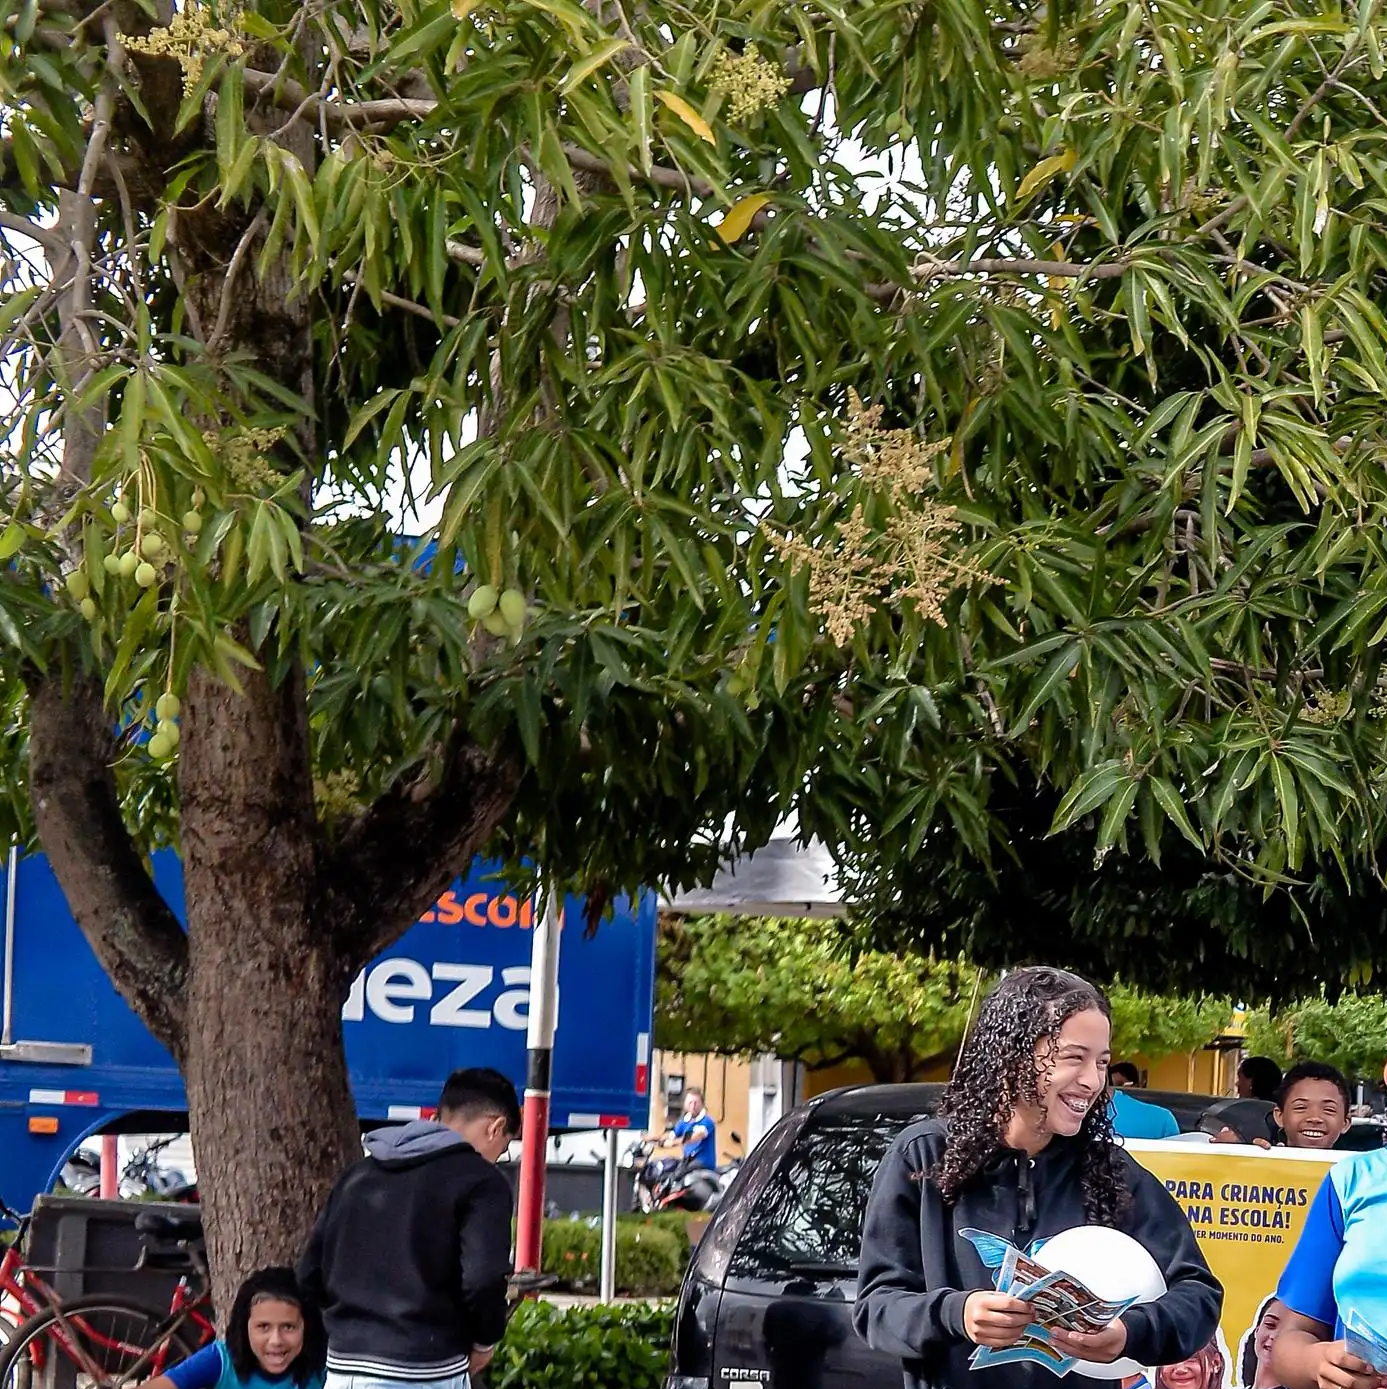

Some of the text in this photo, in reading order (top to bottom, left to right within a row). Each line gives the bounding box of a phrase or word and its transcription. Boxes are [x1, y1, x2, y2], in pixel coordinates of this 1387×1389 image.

[1165, 1180, 1308, 1209] PARA CRIANÇAS
[1187, 1205, 1291, 1229] NA ESCOLA!
[1208, 1230, 1249, 1242] MOMENTO
[1251, 1233, 1263, 1243] DO
[1264, 1234, 1284, 1244] ANO.
[720, 1367, 771, 1382] CORSA
